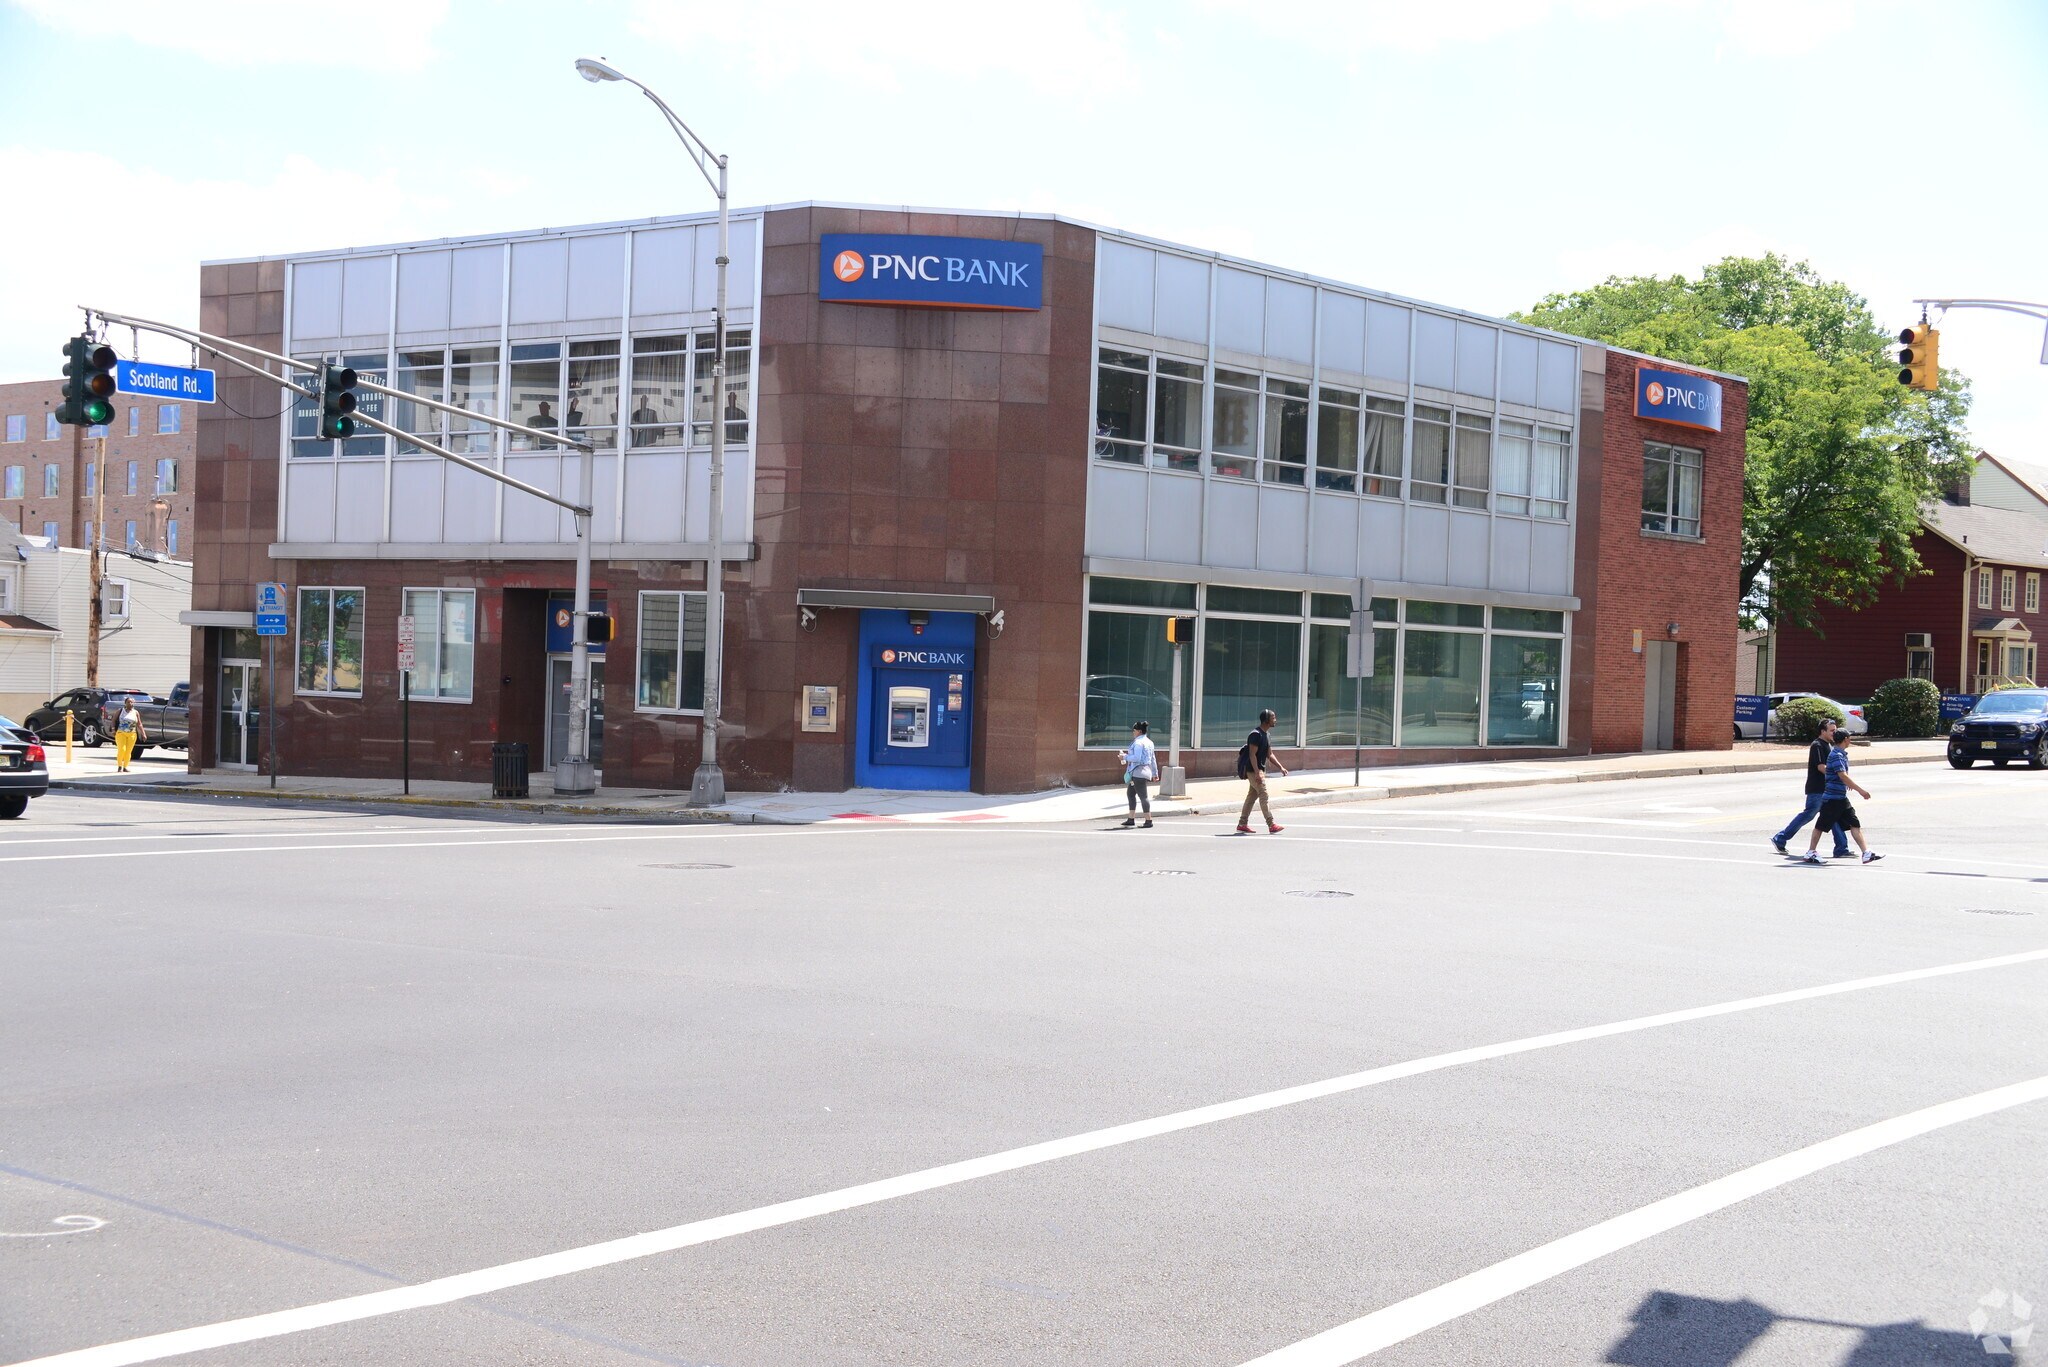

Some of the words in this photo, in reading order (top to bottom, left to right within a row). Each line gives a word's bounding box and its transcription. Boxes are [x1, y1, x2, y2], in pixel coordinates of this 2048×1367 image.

[869, 254, 940, 282] PNC
[943, 257, 1030, 288] BANK
[129, 369, 178, 391] Scotland
[183, 376, 202, 394] Rd.
[1665, 386, 1697, 409] PNC
[898, 651, 927, 663] PNC
[929, 652, 965, 665] BANK
